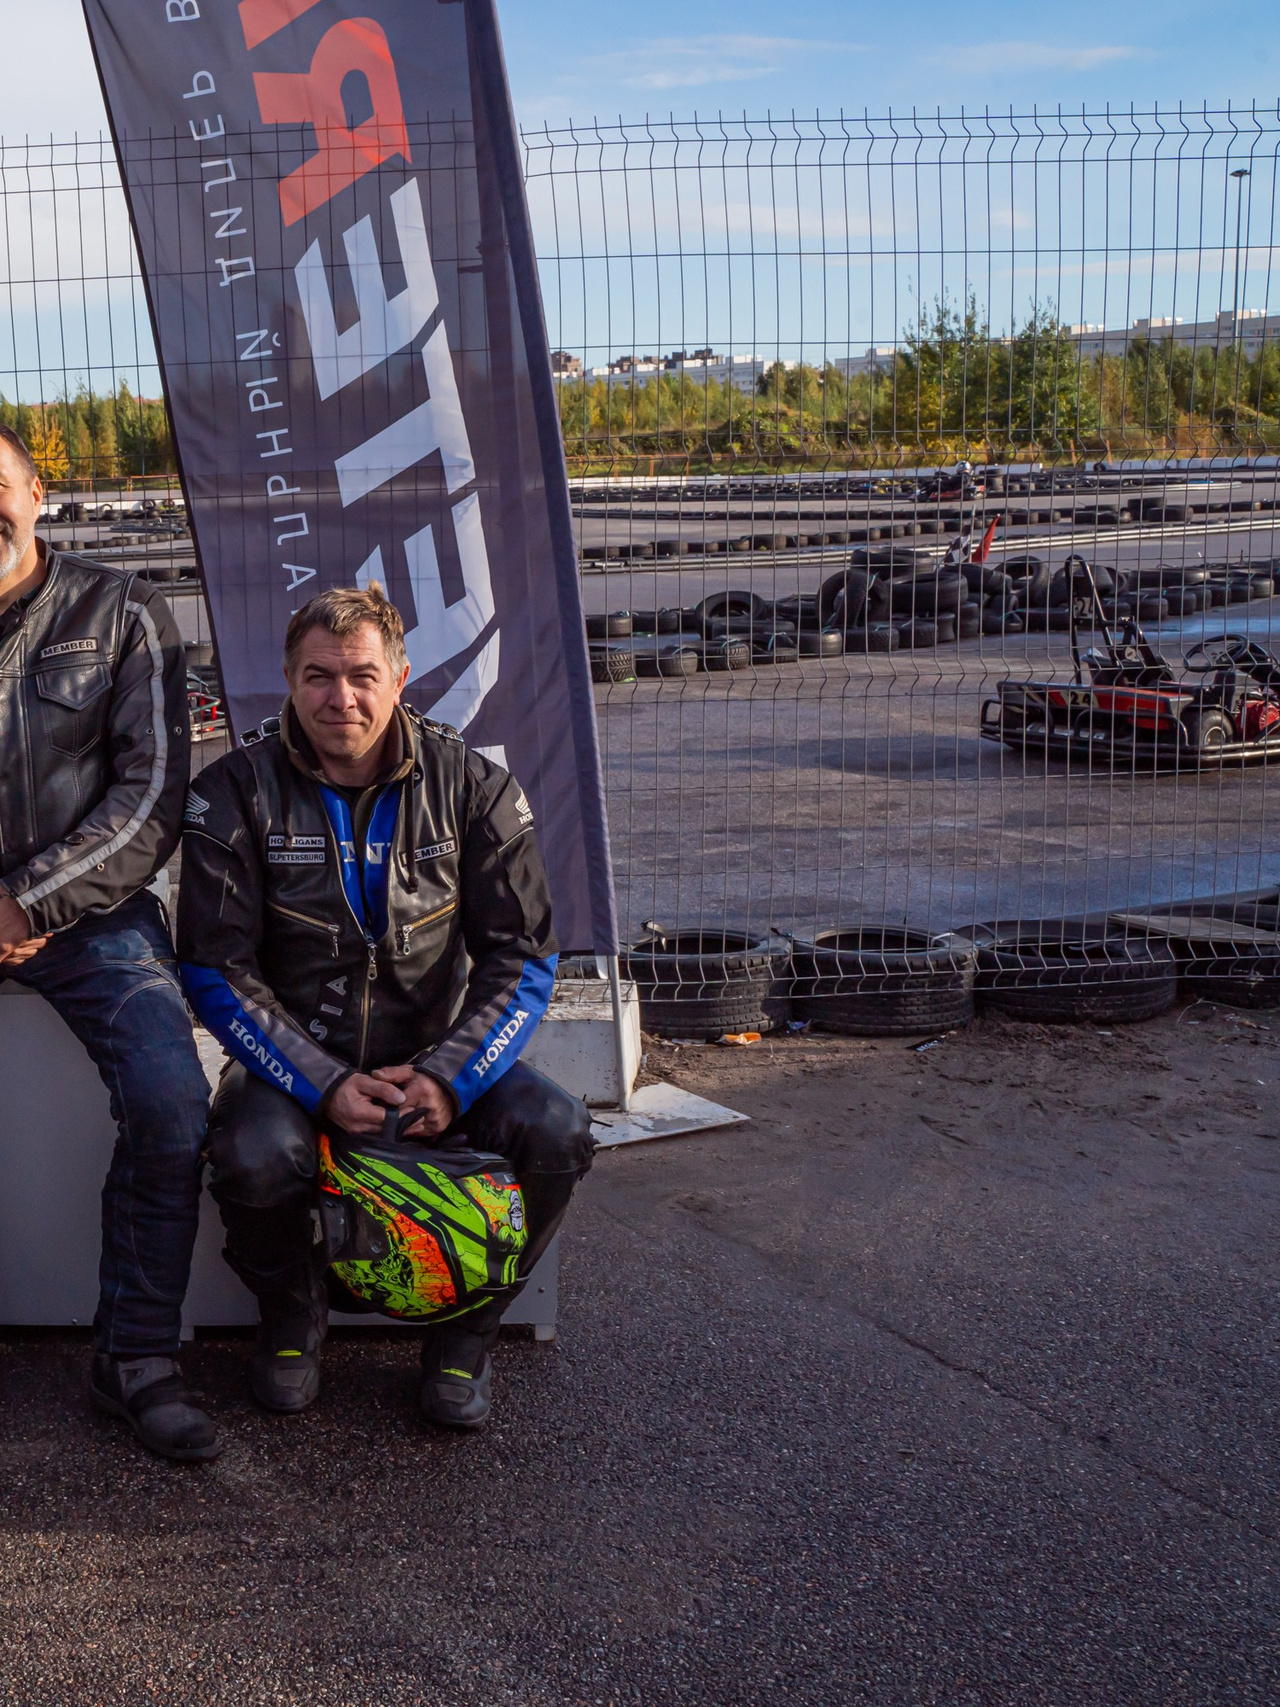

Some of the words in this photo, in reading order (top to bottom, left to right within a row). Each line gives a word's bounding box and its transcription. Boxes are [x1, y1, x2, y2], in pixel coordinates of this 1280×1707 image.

[43, 640, 93, 656] MEMBER
[270, 838, 323, 846] HOIGANS
[410, 842, 453, 861] EMBER
[472, 1008, 529, 1079] HONDA
[228, 1017, 294, 1093] HONDA
